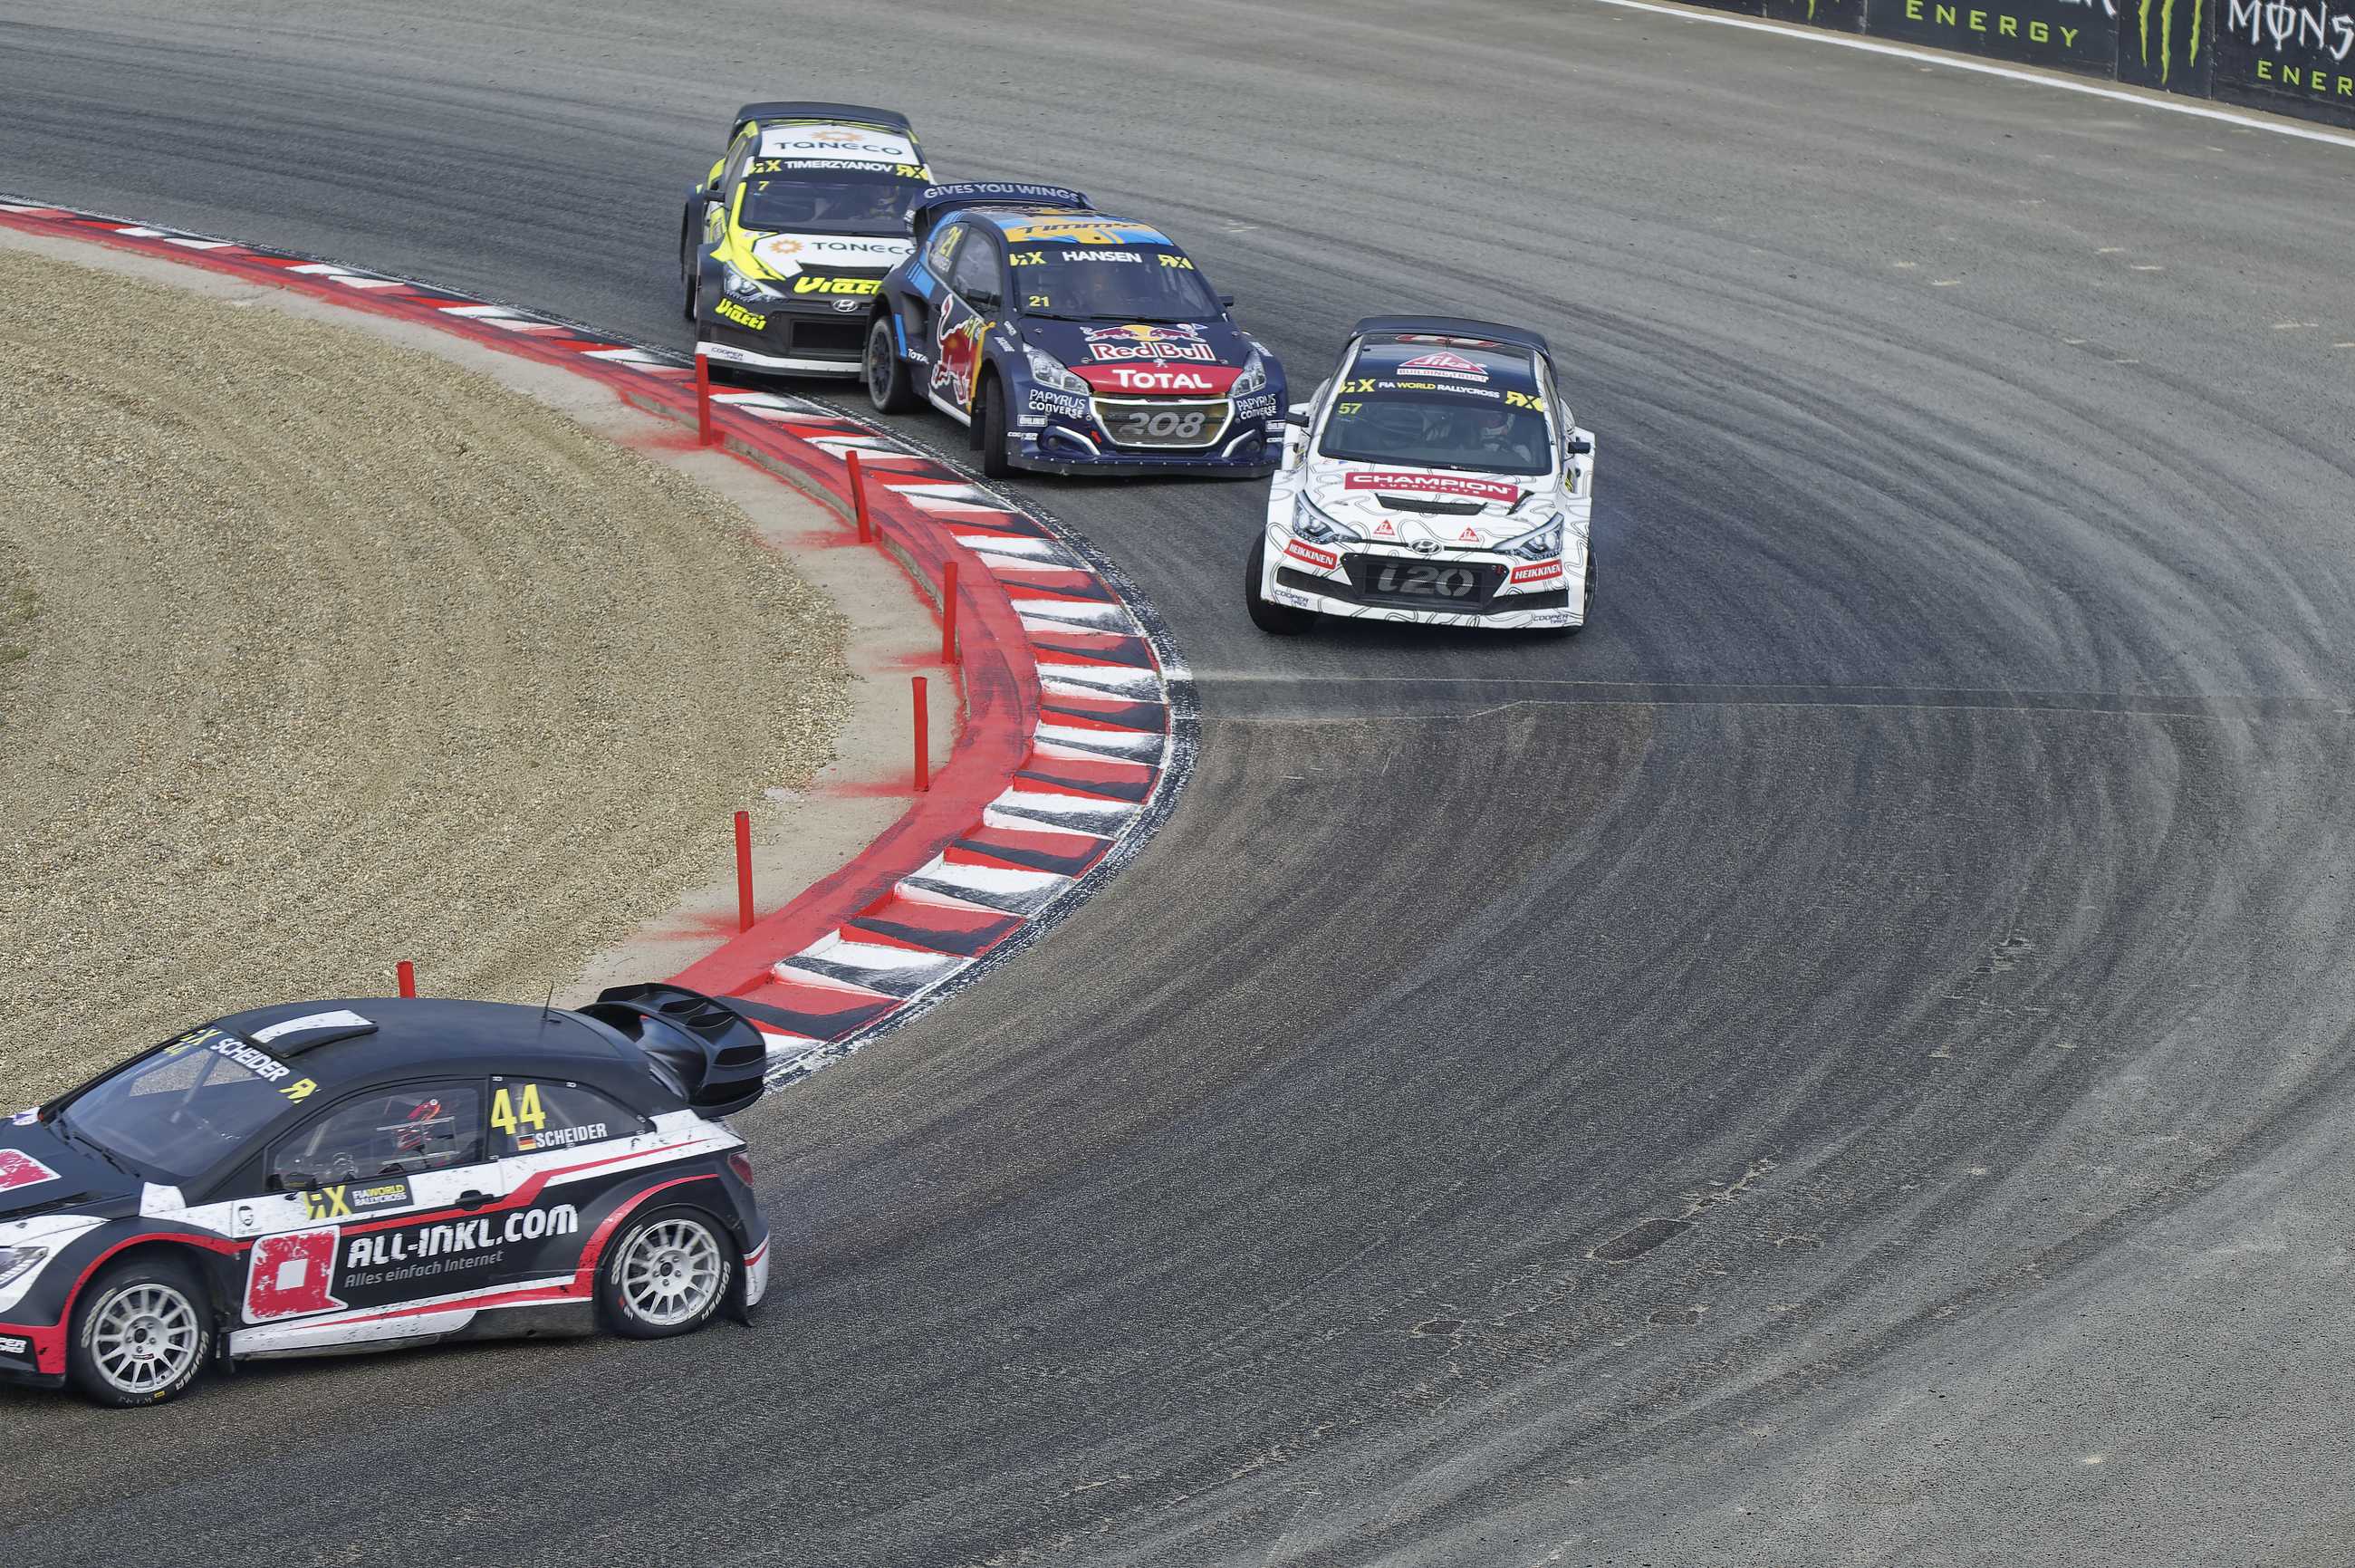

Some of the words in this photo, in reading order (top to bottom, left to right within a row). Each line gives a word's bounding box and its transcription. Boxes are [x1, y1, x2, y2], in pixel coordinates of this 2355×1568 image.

[1905, 0, 2080, 47] ENERGY
[2256, 59, 2354, 97] ENER
[774, 141, 903, 156] TANECO
[784, 160, 893, 172] TIMERZYANOV
[758, 181, 769, 191] 7
[924, 184, 973, 199] GIVES
[975, 183, 1014, 194] YOU
[1015, 185, 1080, 203] WINGS
[1062, 252, 1143, 263] HANSEN
[1028, 295, 1050, 307] 21
[715, 297, 768, 331] Viatti
[1089, 341, 1154, 360] Red
[1155, 343, 1216, 361] Bull
[1111, 369, 1213, 390] TOTAL
[1399, 369, 1450, 378] BUILDING
[1452, 372, 1488, 382] TRUST
[1029, 389, 1086, 409] PAPYRUS
[1397, 382, 1436, 390] WORLD
[1437, 384, 1500, 399] RALLYCROSS
[1337, 402, 1362, 415] 57
[1118, 412, 1206, 438] 208
[1353, 475, 1508, 495] CHAMPION
[1380, 484, 1480, 495] LUBRICANTS
[1289, 543, 1333, 565] HEIKKINEN
[1377, 563, 1475, 598] i20
[1514, 563, 1561, 580] HEIKKINEN
[1274, 590, 1309, 603] COOPER
[210, 1038, 291, 1082] SCHEIDER
[491, 1084, 545, 1135] 44
[536, 1122, 608, 1148] SCHEIDER
[352, 1190, 370, 1200] FIA
[370, 1185, 406, 1197] WORLD
[354, 1194, 407, 1207] RALLYCROSS
[347, 1204, 579, 1268] ALL-INKL.COM
[344, 1272, 384, 1288] Alles
[385, 1260, 442, 1282] einfach
[445, 1251, 504, 1272] Internet
